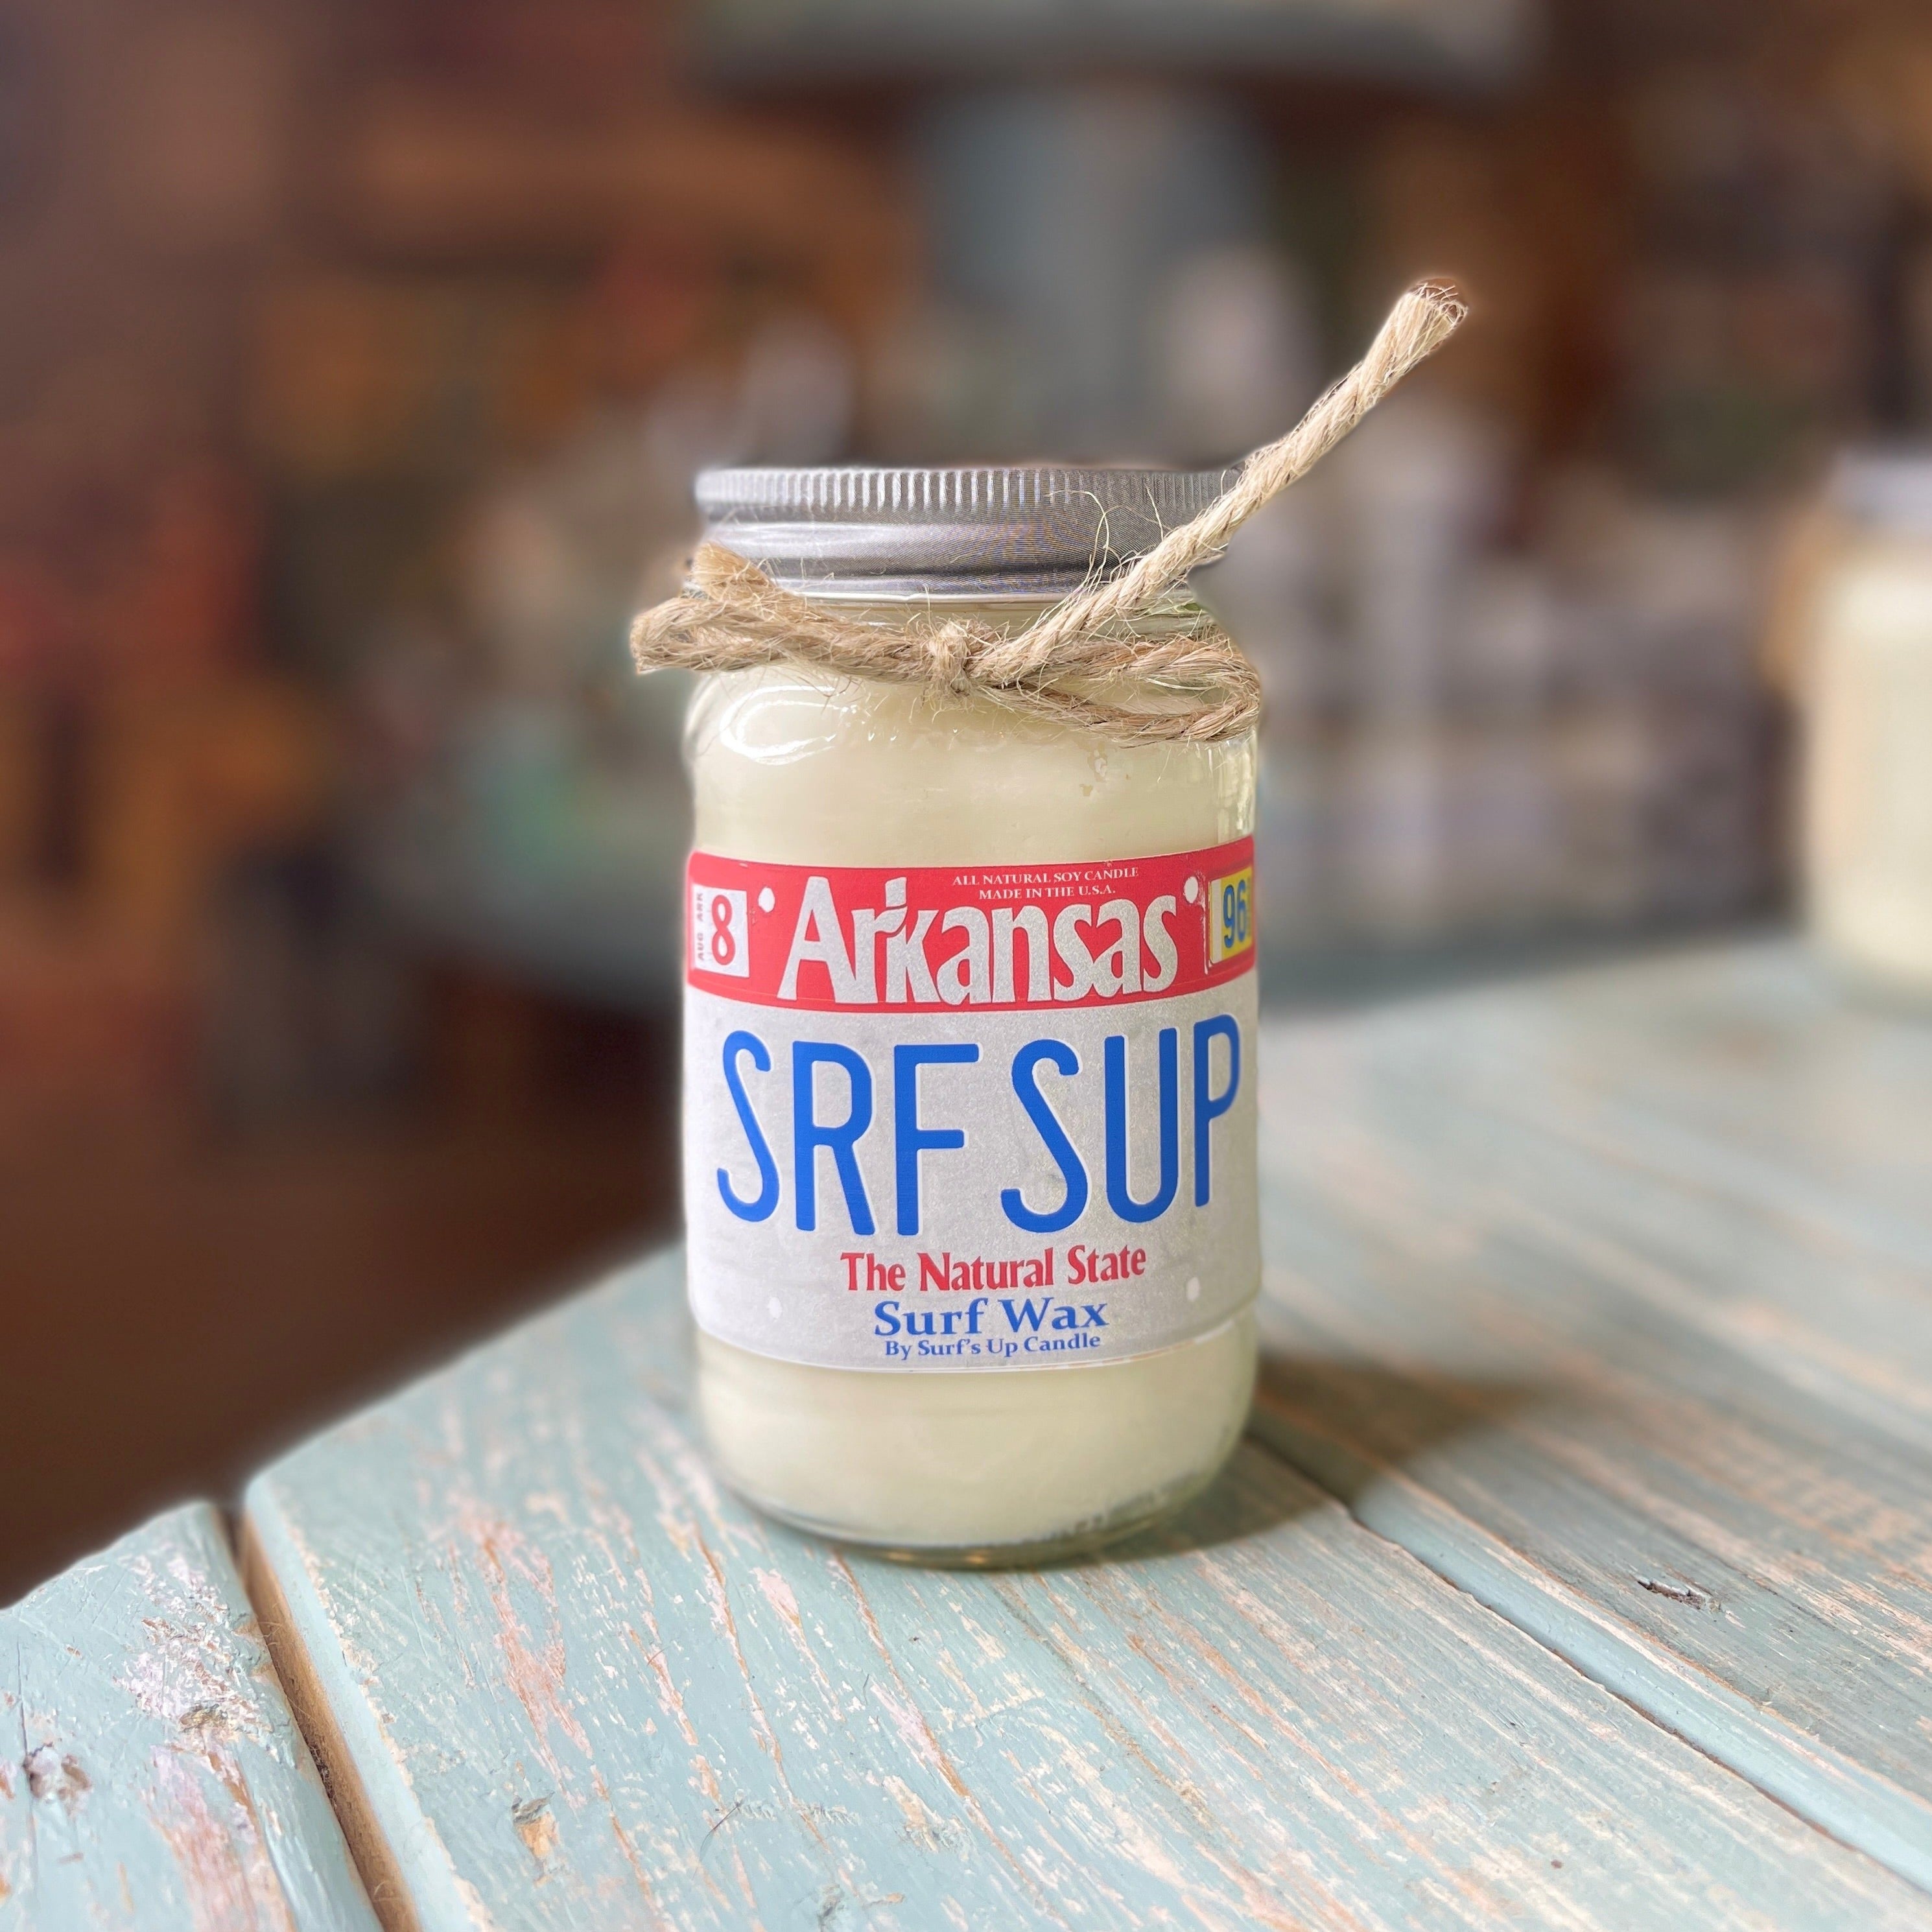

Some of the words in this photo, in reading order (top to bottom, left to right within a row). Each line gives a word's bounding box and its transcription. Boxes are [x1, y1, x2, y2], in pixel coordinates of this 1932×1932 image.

[952, 876, 979, 886] ALL
[983, 873, 1051, 885] NATURAL
[1054, 871, 1081, 884] SOY
[1085, 867, 1139, 880] CANDLE
[979, 889, 1022, 900] MADE
[1026, 888, 1044, 899] IN
[1044, 886, 1074, 897] THE
[1079, 885, 1116, 896] U.S.A.
[712, 895, 735, 965] 8
[1223, 879, 1246, 948] 96
[777, 876, 1178, 1005] Arkansas
[717, 1030, 980, 1236] SRF
[1001, 1014, 1241, 1233] SUP
[840, 1253, 906, 1291] The
[917, 1247, 1054, 1291] Natural
[1067, 1245, 1146, 1284] State
[875, 1297, 989, 1336] Surf
[998, 1297, 1109, 1332] Wax
[886, 1341, 912, 1360] By
[918, 1339, 981, 1356] Surf's
[986, 1338, 1019, 1357] Up
[1024, 1333, 1100, 1352] Candle
